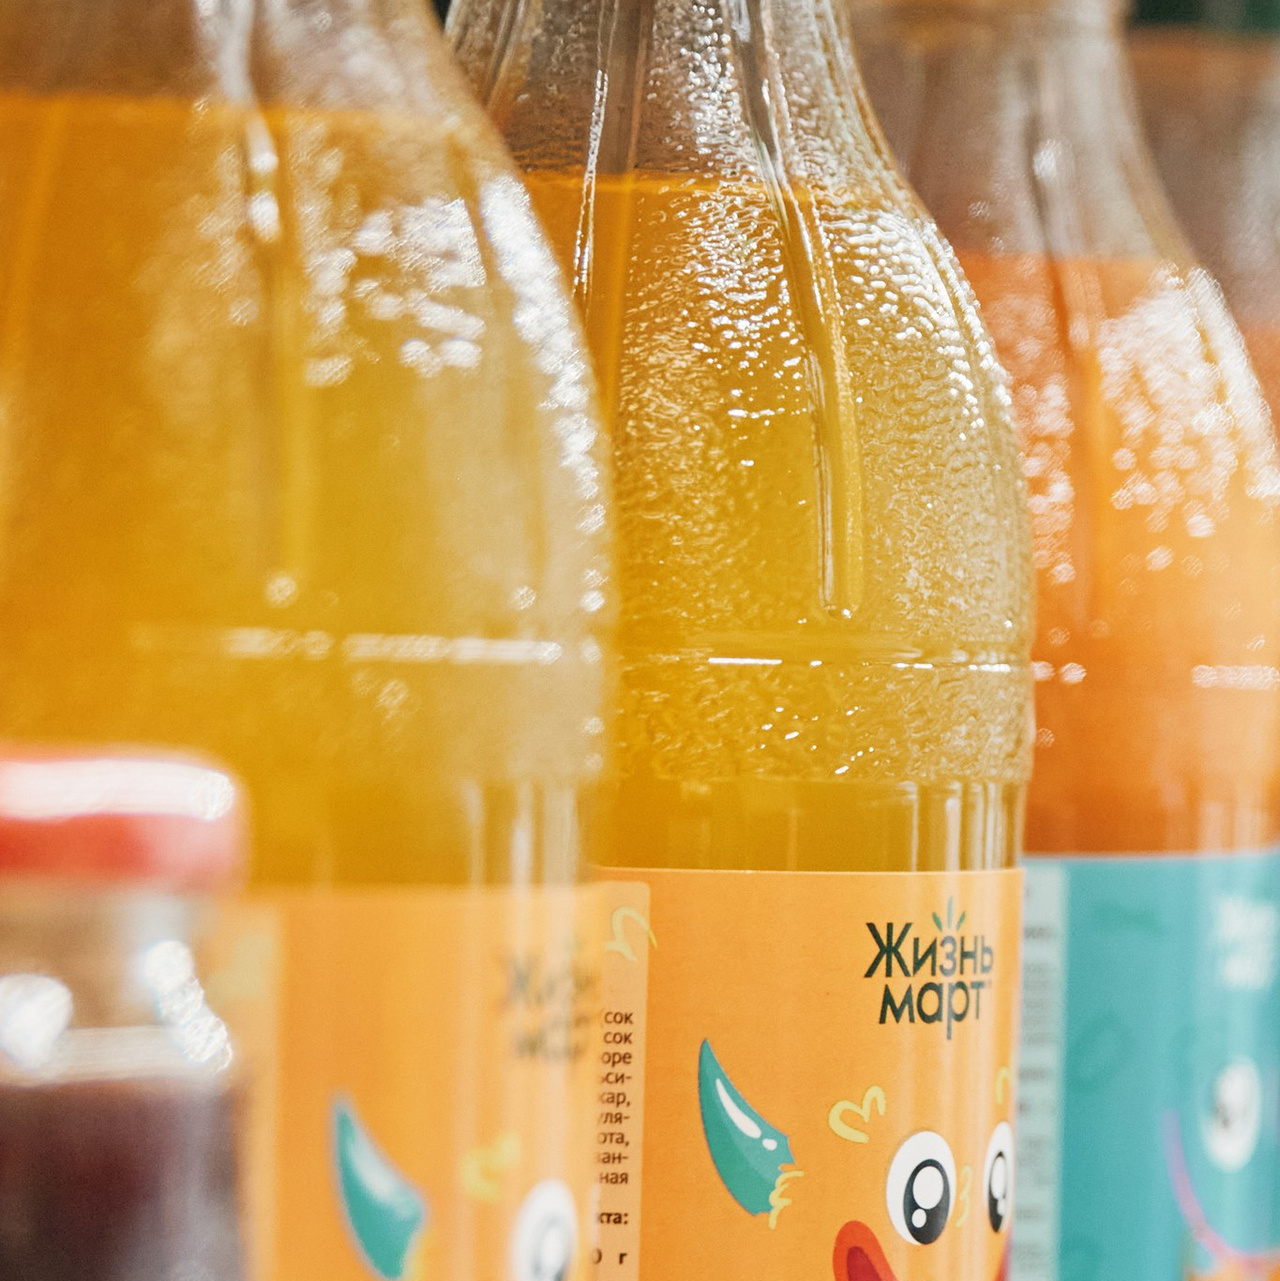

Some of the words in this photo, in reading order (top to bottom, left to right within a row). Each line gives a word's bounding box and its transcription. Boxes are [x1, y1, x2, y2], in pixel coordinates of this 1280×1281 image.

[863, 922, 994, 979] Жизнь
[603, 1031, 632, 1045] сок
[878, 981, 987, 1040] март
